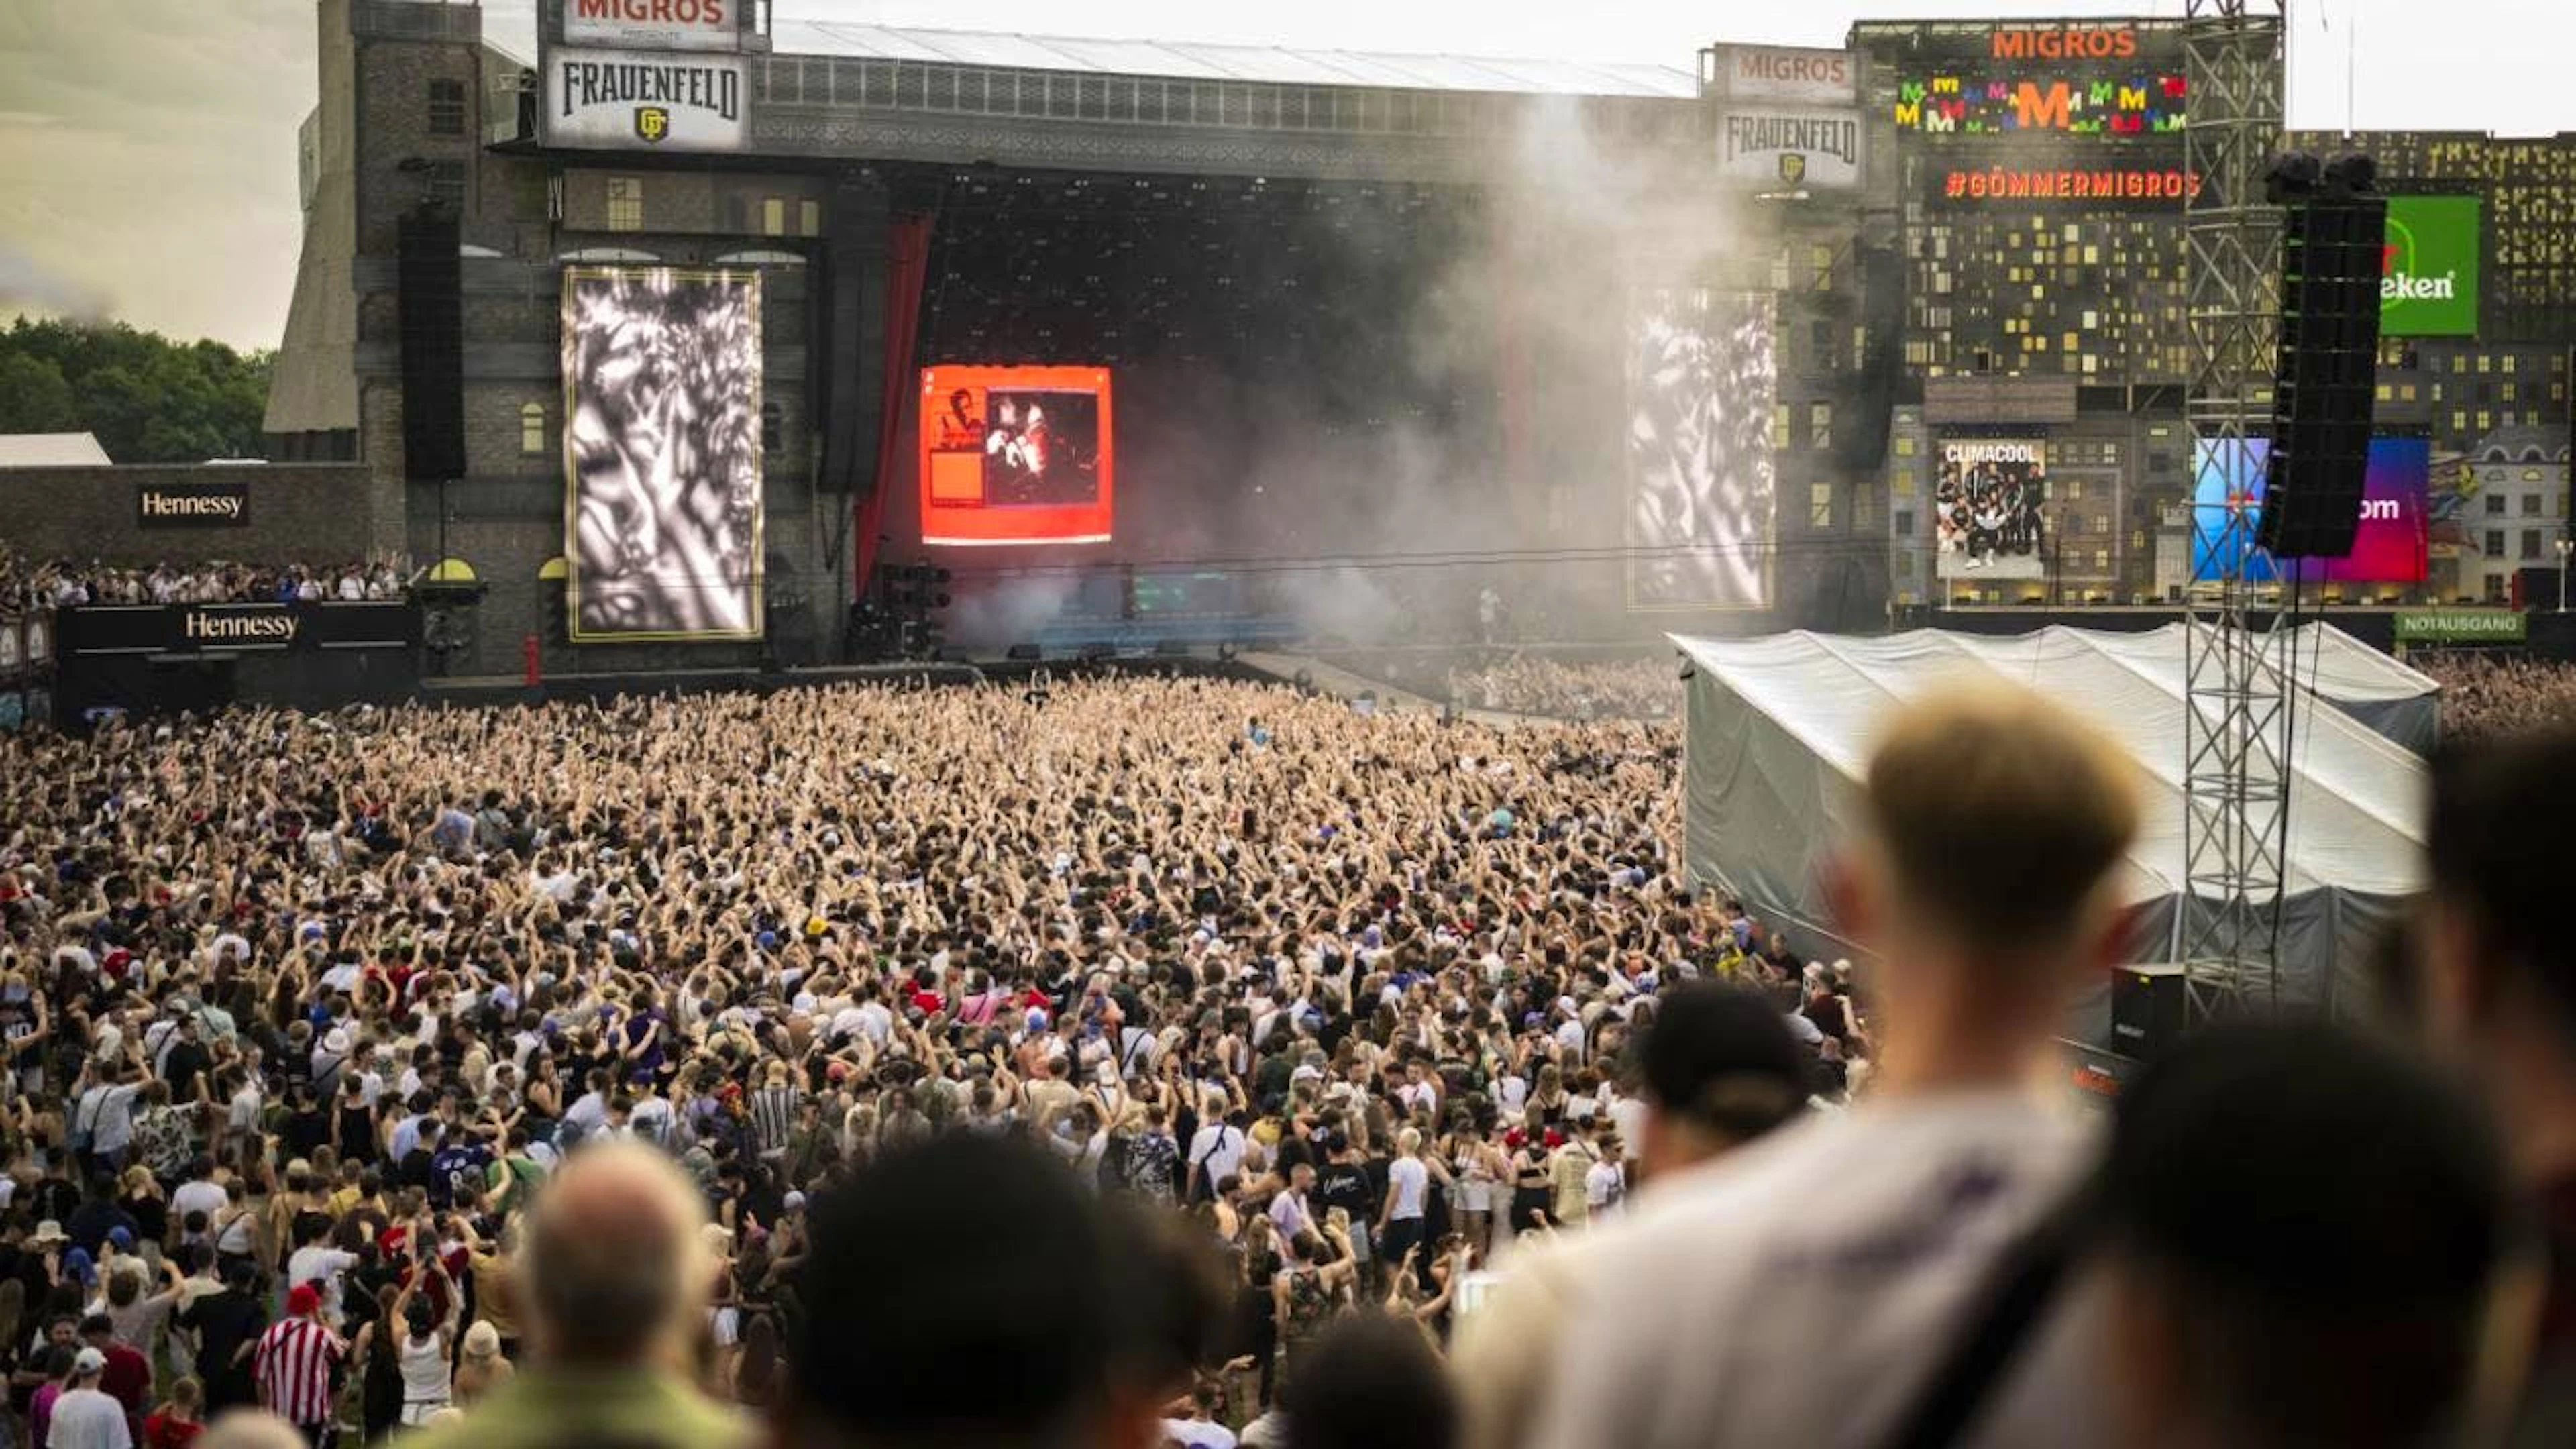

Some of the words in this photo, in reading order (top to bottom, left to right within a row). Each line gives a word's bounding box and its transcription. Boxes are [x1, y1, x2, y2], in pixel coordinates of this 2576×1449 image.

[578, 0, 722, 23] MIGROS
[1993, 30, 2136, 58] MIGROS
[1739, 54, 1845, 83] MIGROS
[563, 62, 738, 121] FRAUENFELD
[2017, 80, 2070, 129] M
[1727, 116, 1855, 164] FRAUENFELD
[1945, 443, 2036, 462] CLIMACOOL
[143, 492, 243, 519] Hennessy
[186, 612, 299, 640] Hennessy
[2404, 616, 2517, 631] NOTAUSGANG
